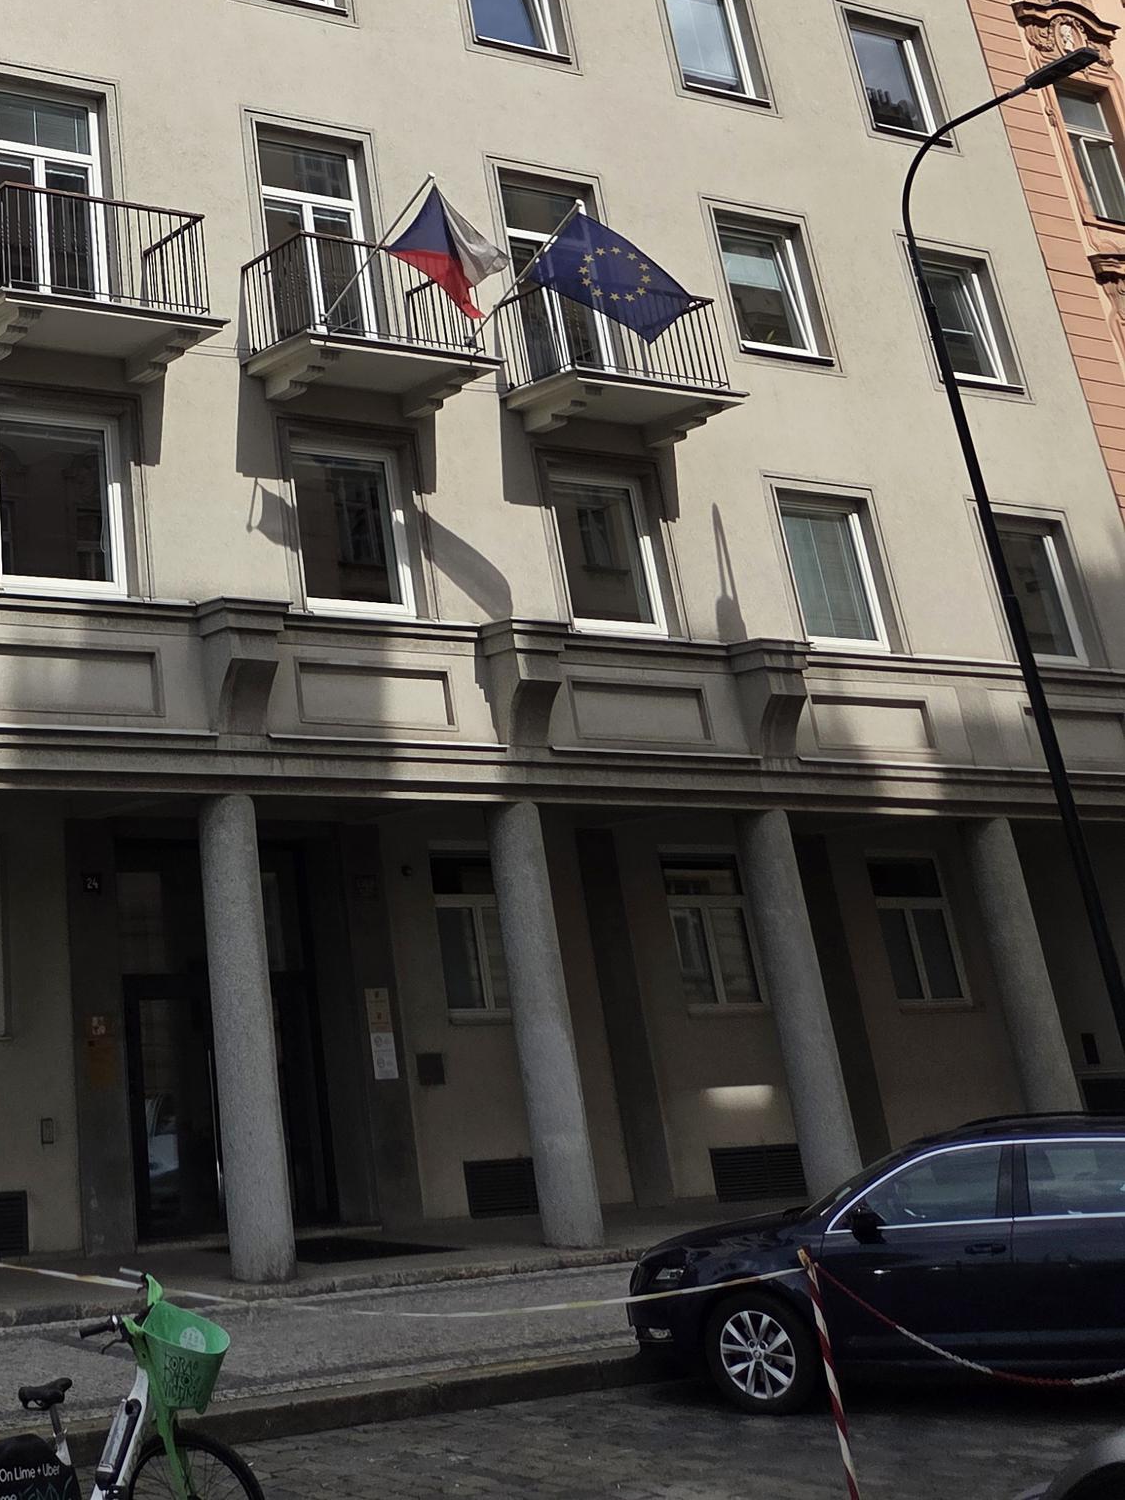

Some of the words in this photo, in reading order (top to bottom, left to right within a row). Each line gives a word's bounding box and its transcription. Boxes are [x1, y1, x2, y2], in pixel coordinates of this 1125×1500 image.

[87, 877, 99, 889] 24
[13, 1466, 36, 1481] Lime
[42, 1462, 60, 1477] Uber
